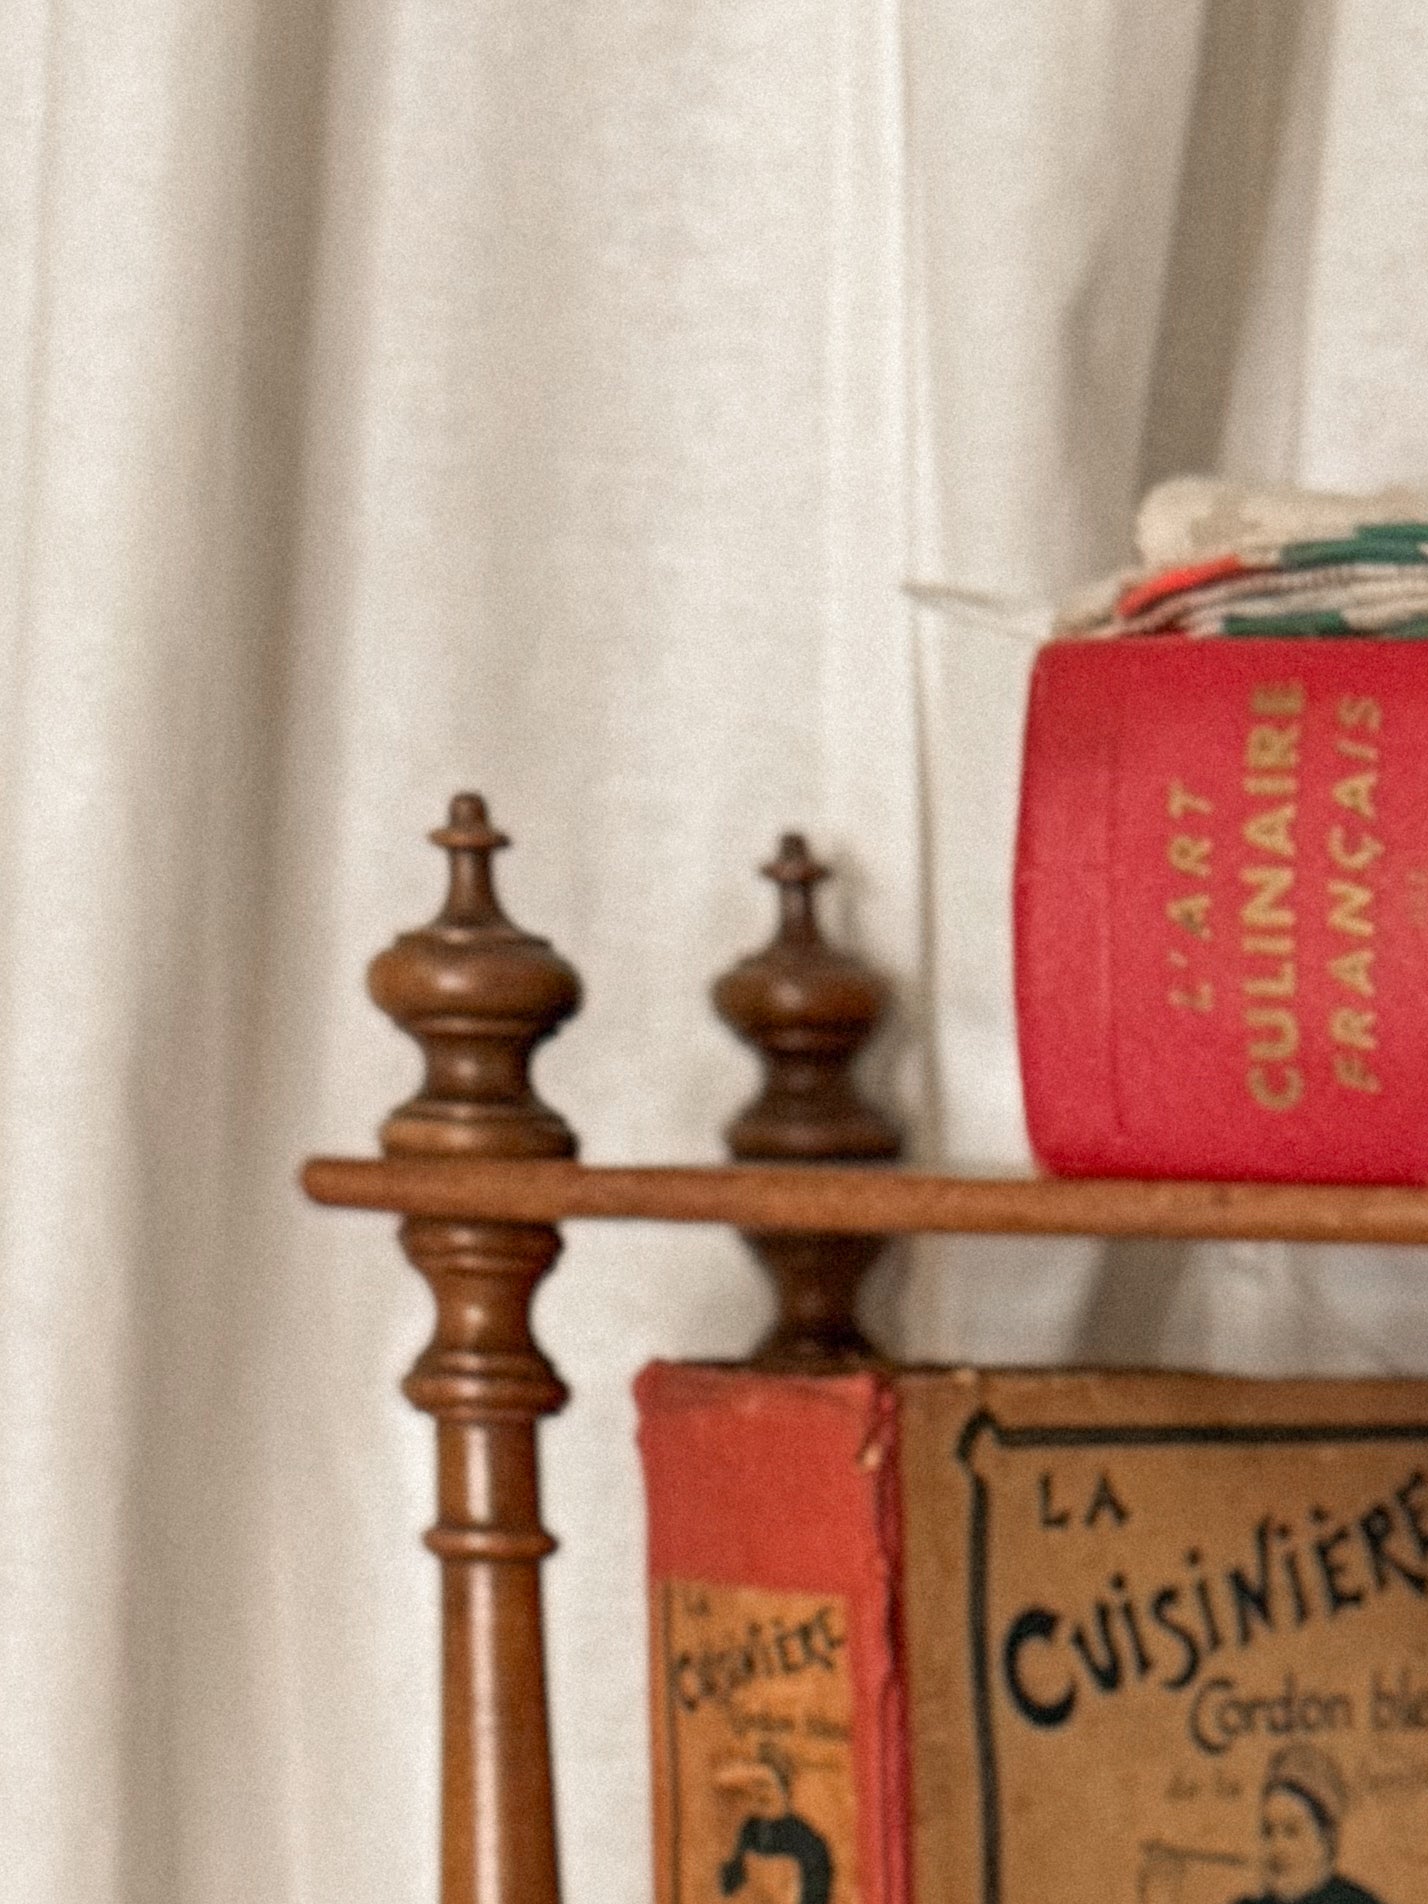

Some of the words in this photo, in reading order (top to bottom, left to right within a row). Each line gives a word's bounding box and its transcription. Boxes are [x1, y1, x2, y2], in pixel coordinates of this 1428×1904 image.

[1166, 778, 1213, 1014] L'ART
[1241, 679, 1307, 1111] CULINAIRE
[1327, 695, 1384, 1094] FRANÇAIS
[1037, 1470, 1131, 1530] LA
[1187, 1668, 1352, 1754] Cordon
